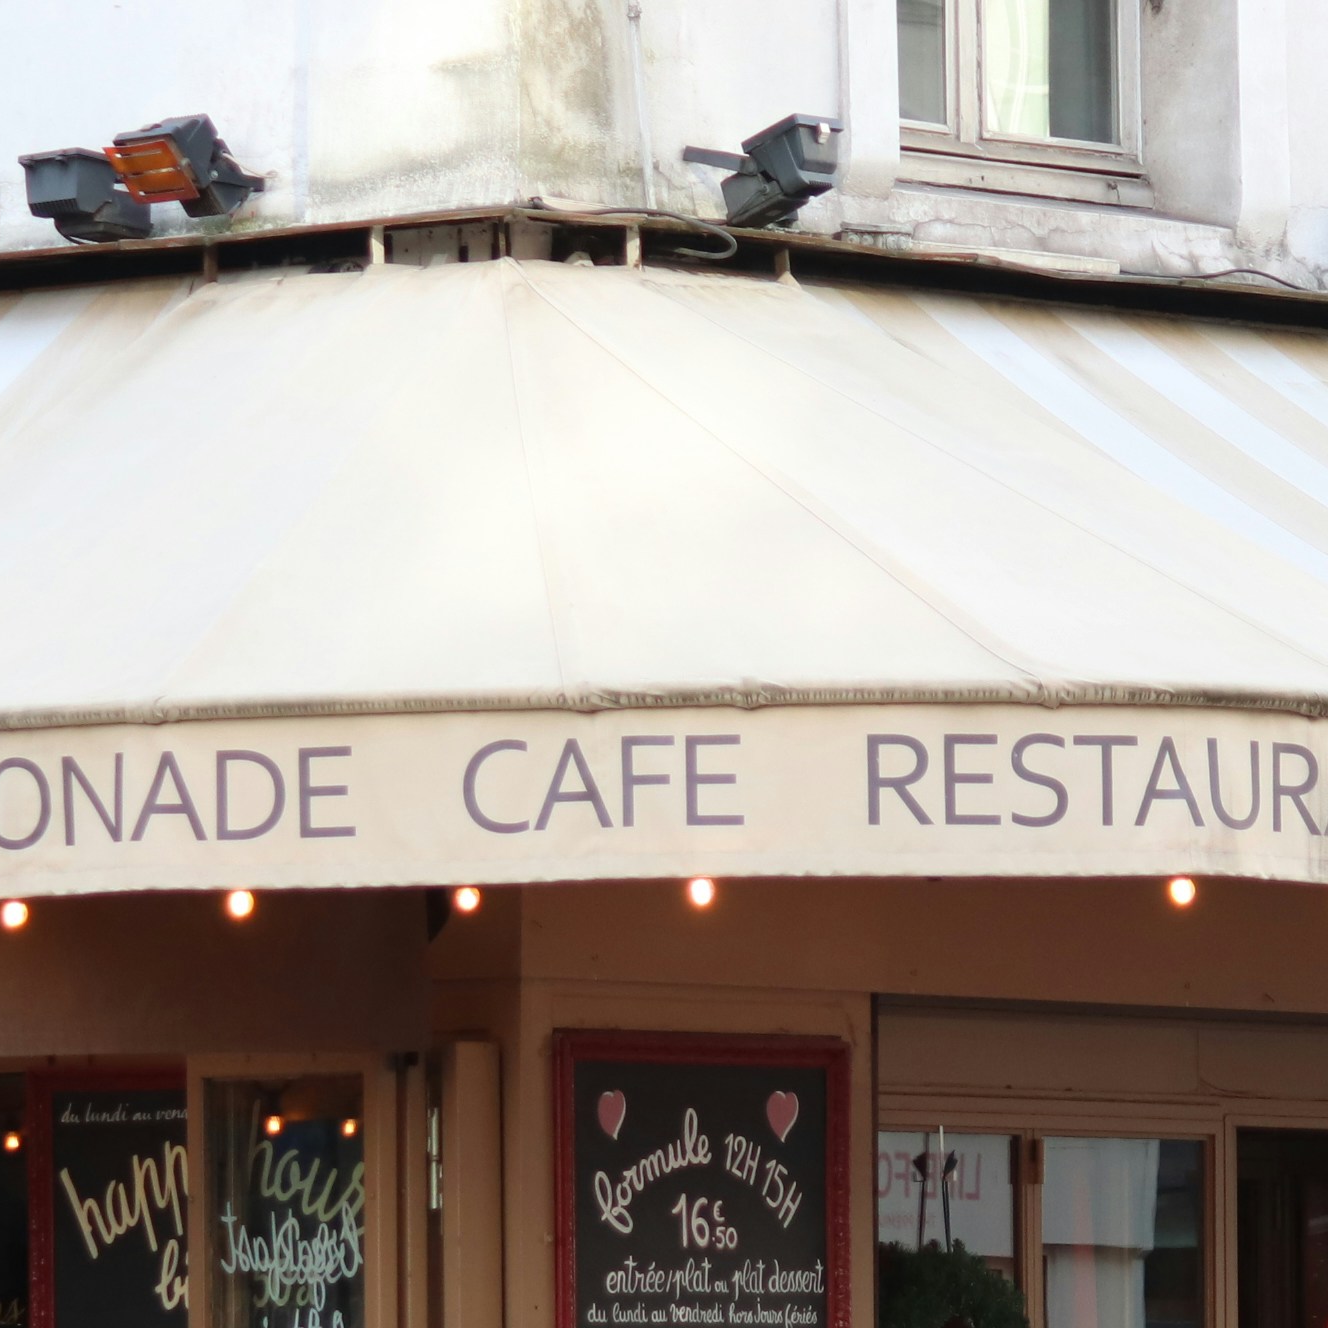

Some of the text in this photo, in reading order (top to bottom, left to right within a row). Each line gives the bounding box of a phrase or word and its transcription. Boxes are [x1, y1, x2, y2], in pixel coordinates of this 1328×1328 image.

[461, 733, 746, 834] CAFE
[60, 1103, 80, 1123] du
[85, 1102, 129, 1123] lundi
[132, 1111, 152, 1121] au
[594, 1107, 713, 1234] formule
[724, 1132, 762, 1186] 12H
[762, 1159, 803, 1229] 15H
[714, 1278, 729, 1294] ou
[732, 1258, 765, 1301] plat
[768, 1258, 825, 1294] dessert
[587, 1302, 609, 1323] du
[612, 1301, 649, 1323] lundi
[651, 1311, 668, 1323] au
[670, 1302, 725, 1323] vendredi
[728, 1302, 754, 1323] hors
